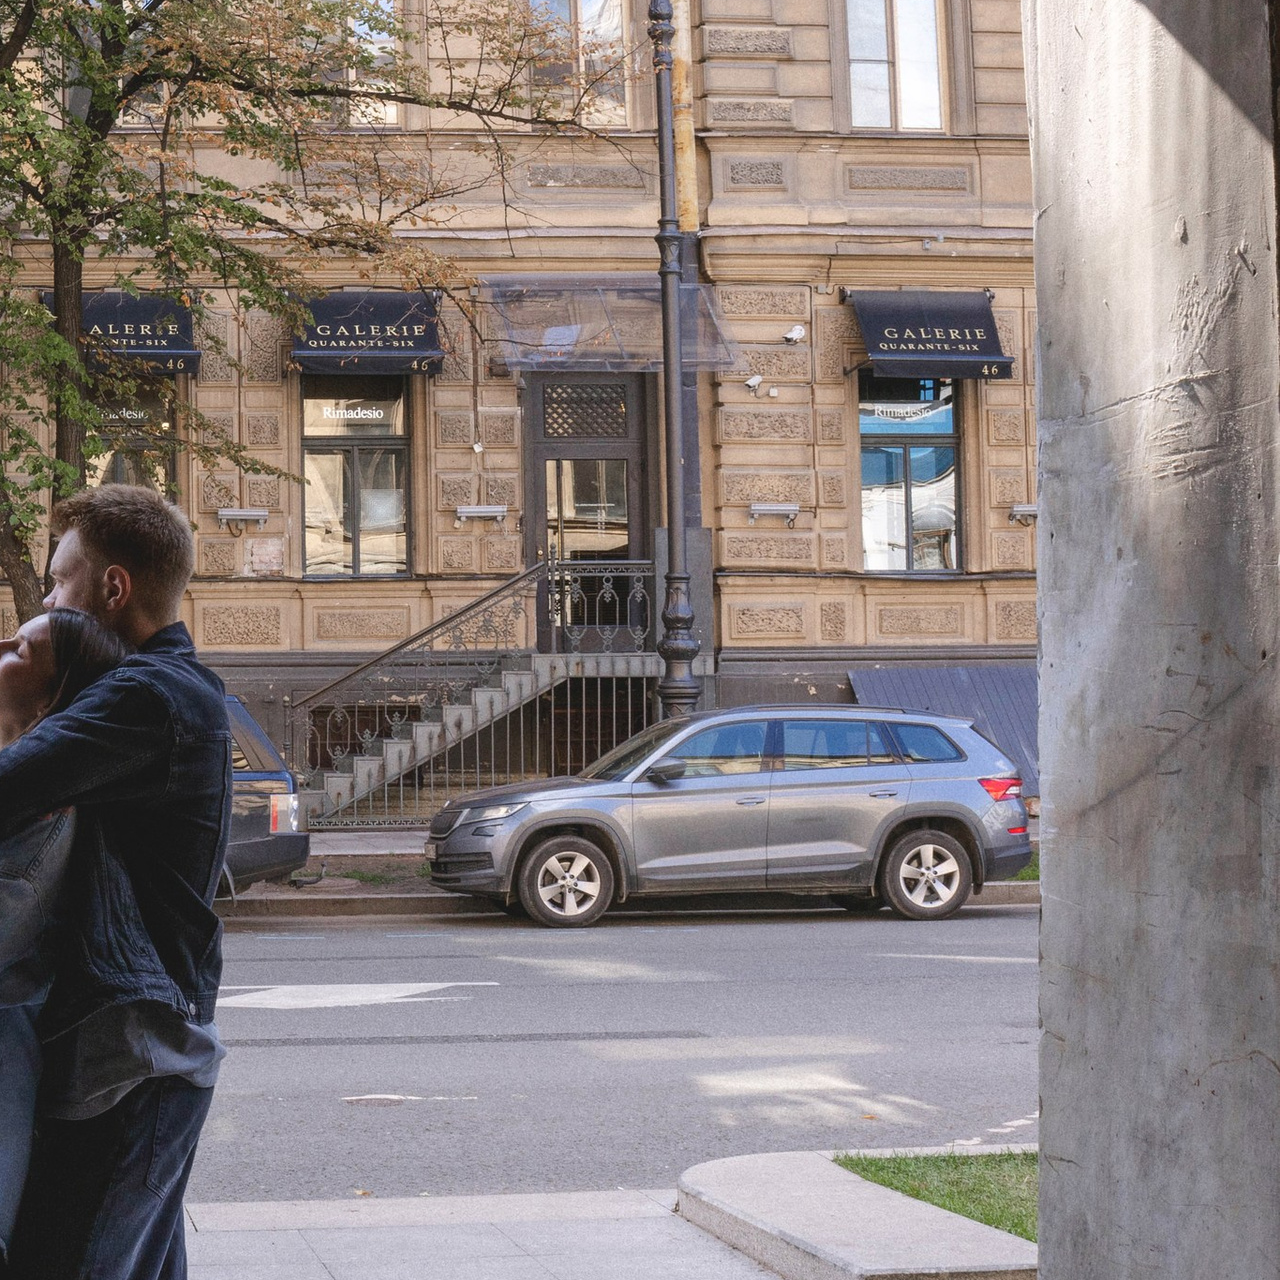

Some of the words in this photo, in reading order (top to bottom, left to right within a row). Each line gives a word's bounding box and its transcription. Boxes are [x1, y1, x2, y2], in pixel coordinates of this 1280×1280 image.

[89, 324, 179, 335] ALERE
[317, 325, 426, 336] GALERIE
[884, 328, 987, 340] GALERIE
[879, 342, 980, 351] QUARANTE-SIX
[166, 359, 185, 370] 46
[411, 360, 428, 371] 46
[982, 364, 999, 376] 46
[323, 407, 384, 419] Rimadesio
[874, 405, 932, 418] Rimadesio
